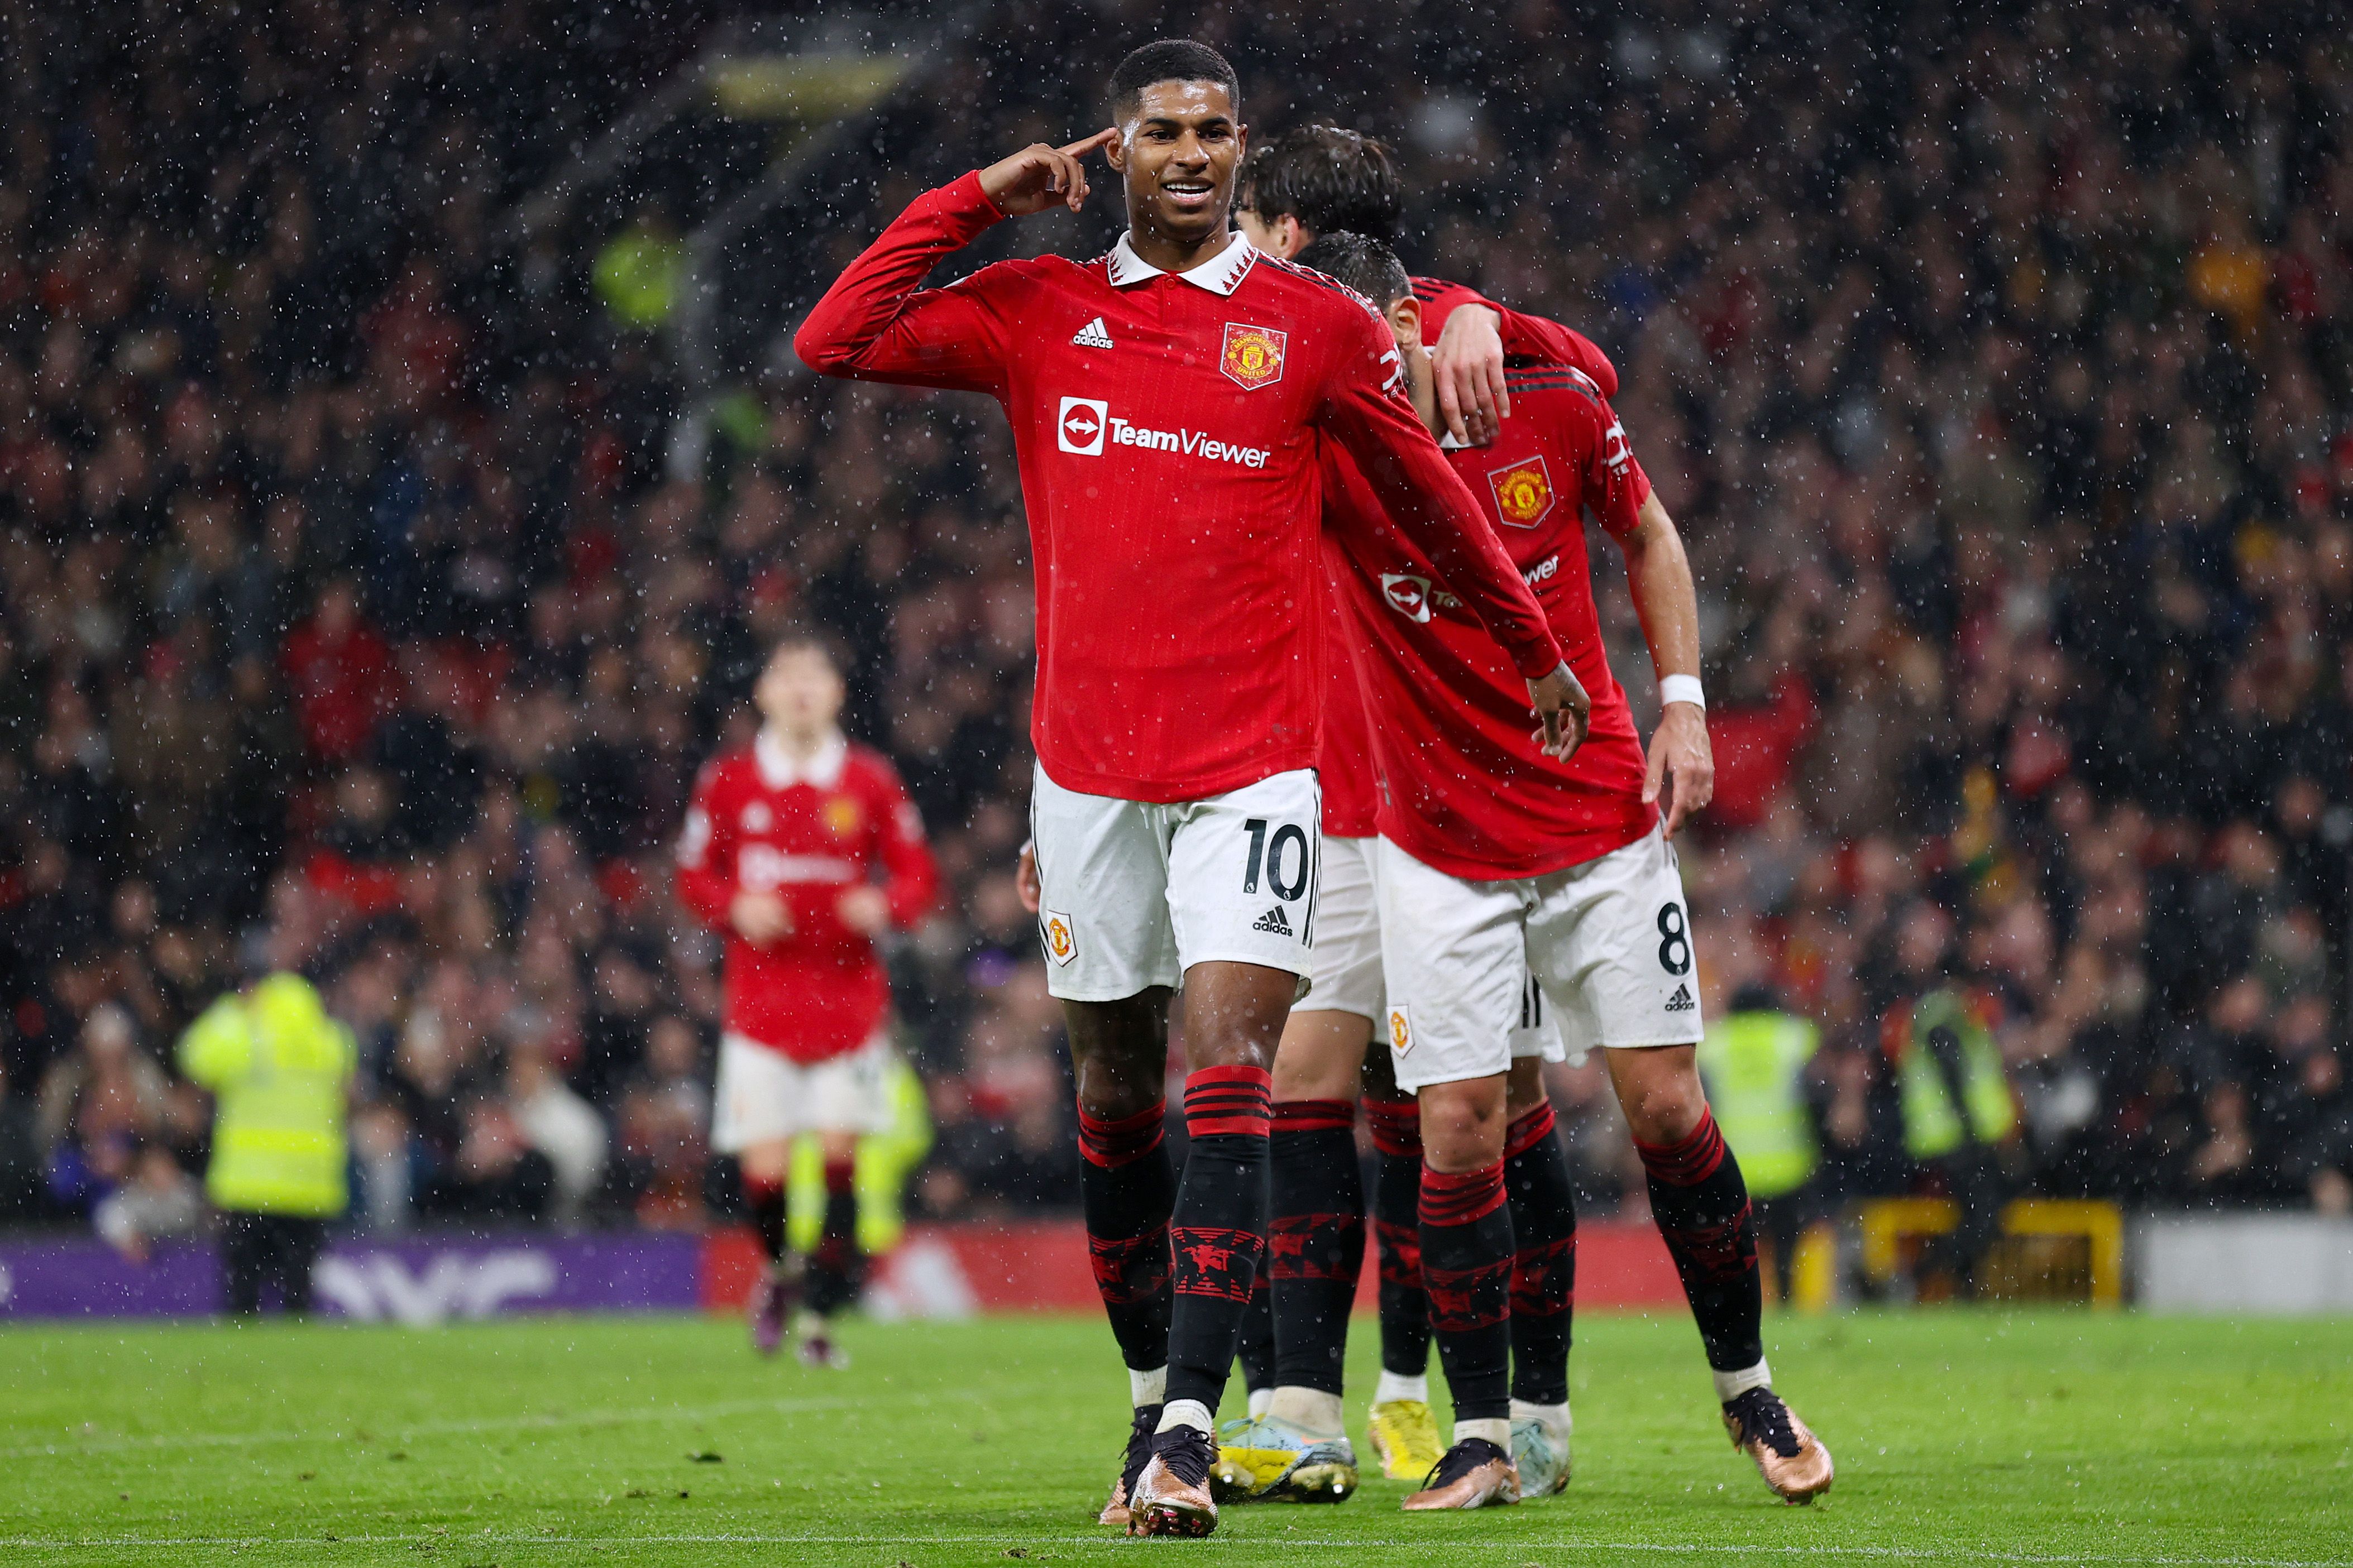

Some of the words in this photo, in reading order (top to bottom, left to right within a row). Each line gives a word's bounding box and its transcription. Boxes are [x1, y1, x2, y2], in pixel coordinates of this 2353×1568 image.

[1073, 334, 1113, 349] adidas
[1234, 336, 1275, 356] MANCHESTE
[1237, 366, 1266, 376] UNITED
[1109, 417, 1271, 469] TeamViewer
[1244, 818, 1308, 901] 10
[1252, 922, 1293, 937] adidas
[1657, 902, 1690, 976] 8
